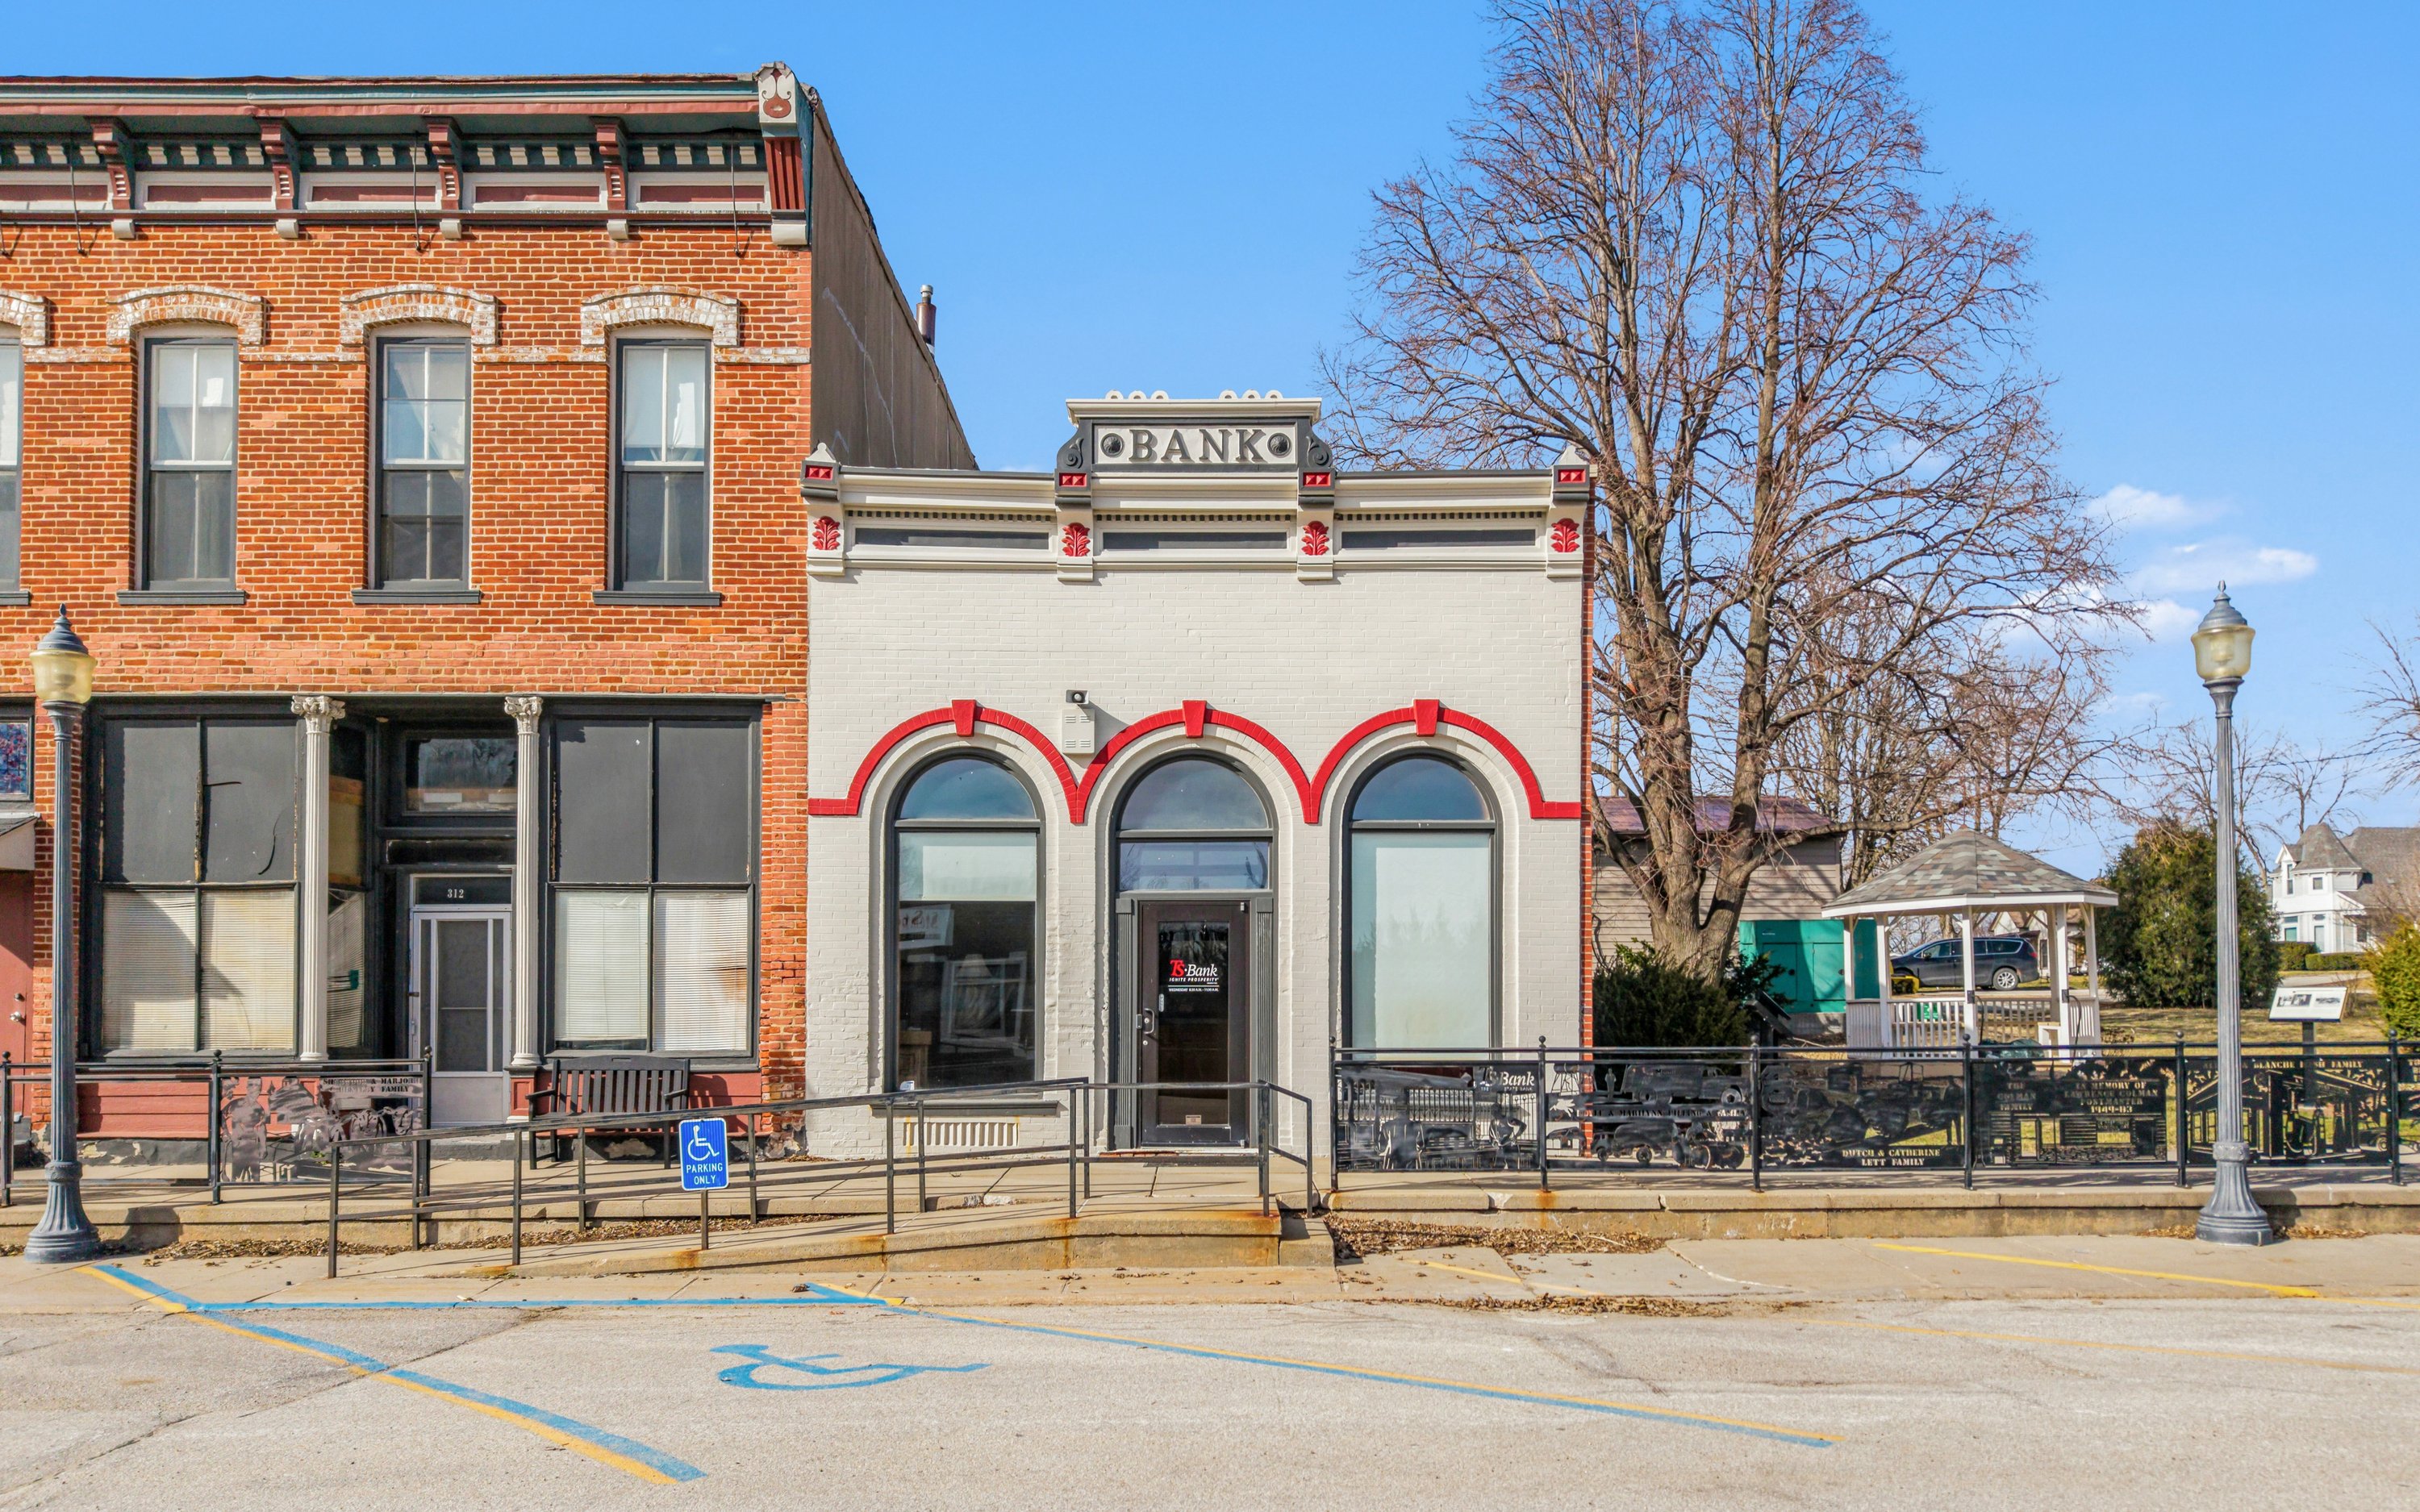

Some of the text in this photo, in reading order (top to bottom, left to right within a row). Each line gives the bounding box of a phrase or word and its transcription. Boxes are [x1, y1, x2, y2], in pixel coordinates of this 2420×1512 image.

[1128, 428, 1267, 463] BANK
[447, 889, 465, 898] 312
[2330, 1060, 2364, 1068] FAMILY
[2092, 1081, 2130, 1089] MEMORY
[2134, 1081, 2147, 1089] OF
[1842, 1148, 1875, 1157] DUTCH
[1888, 1148, 1941, 1156] CATHERINE
[1861, 1158, 1925, 1166] LETT FAMILY
[686, 1163, 723, 1173] PARKING
[694, 1175, 716, 1185] ONLY
